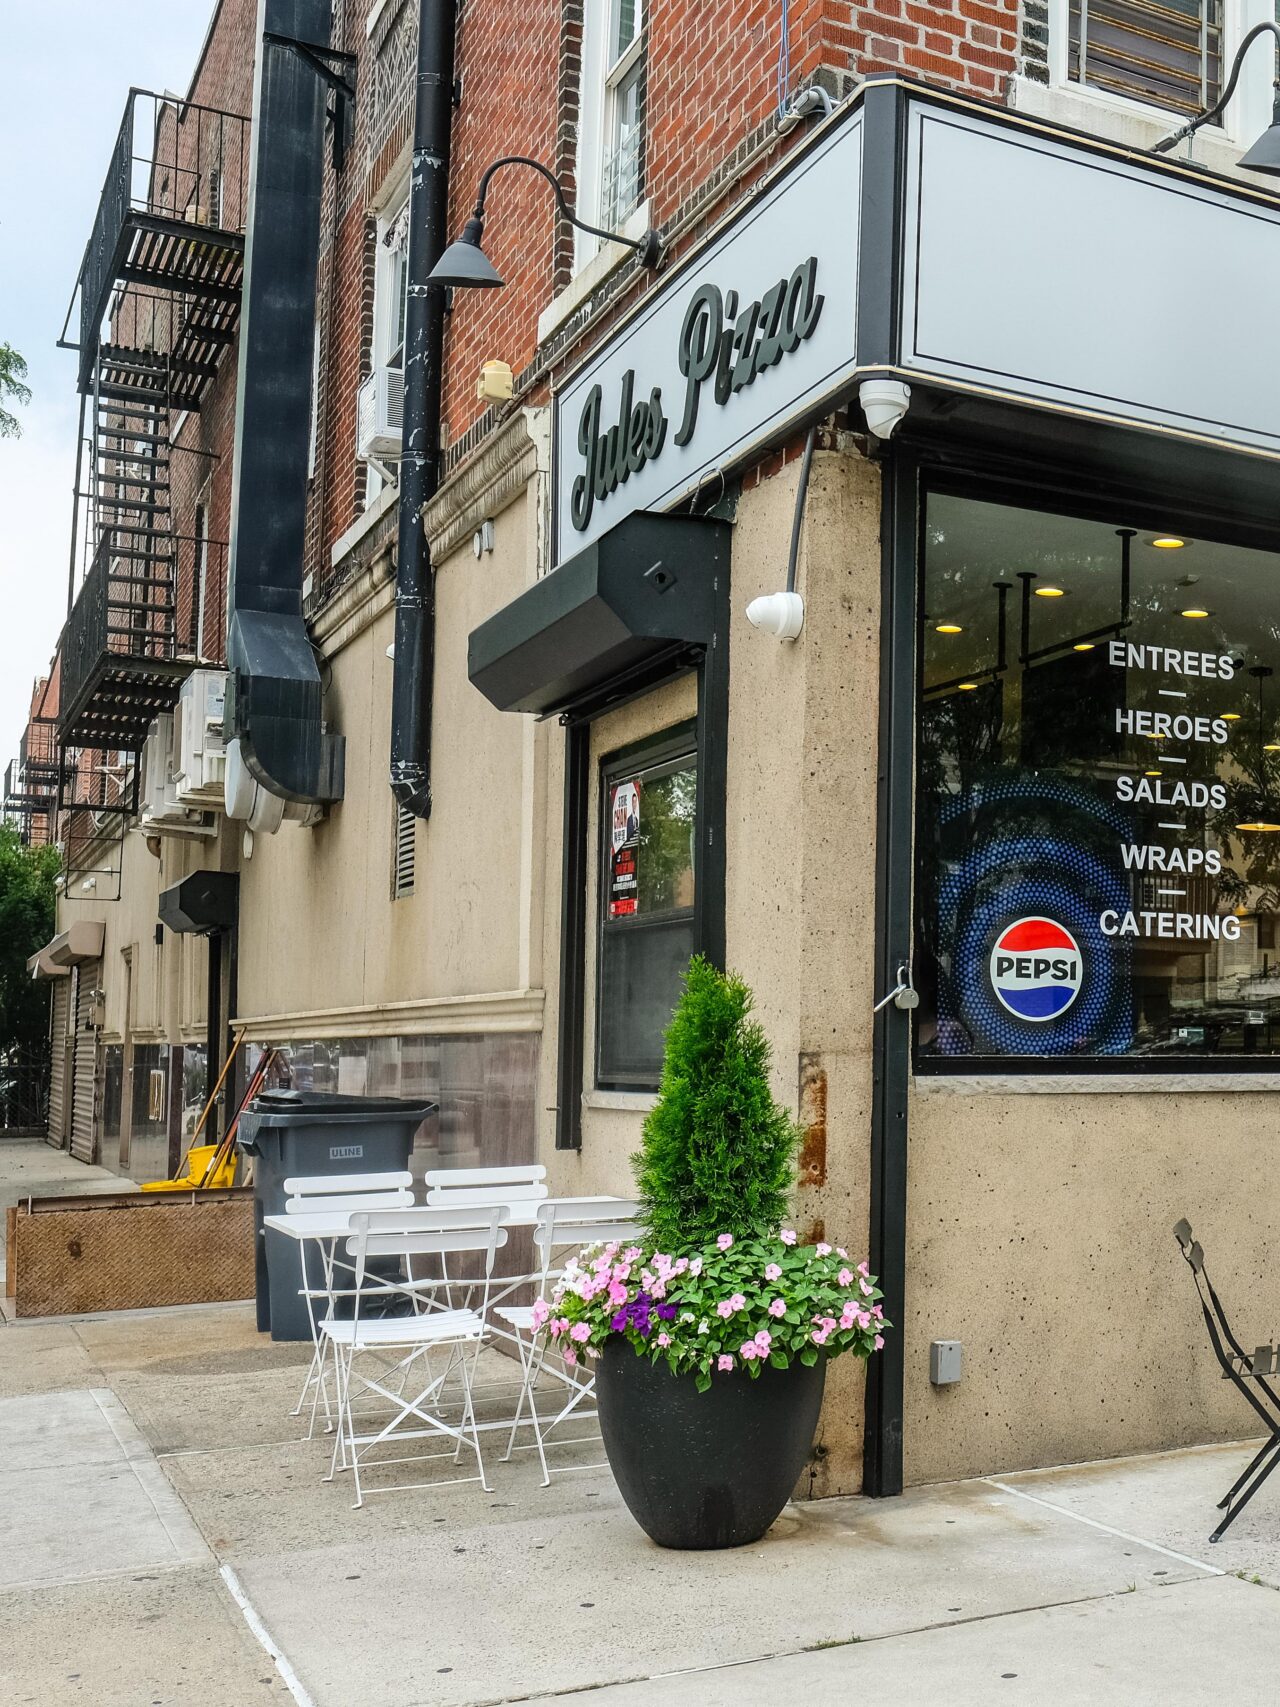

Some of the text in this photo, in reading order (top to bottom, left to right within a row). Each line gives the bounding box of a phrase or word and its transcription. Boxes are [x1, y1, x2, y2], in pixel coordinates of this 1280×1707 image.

[571, 256, 825, 531] Jules Pizza
[1109, 640, 1235, 680] ENTREES
[1115, 709, 1228, 744] HEROES
[1116, 776, 1227, 810] SALADS
[1120, 844, 1221, 875] WRAPS
[1100, 909, 1241, 940] CATERING
[997, 955, 1077, 982] PEPSI
[331, 1147, 361, 1158] ULINE
